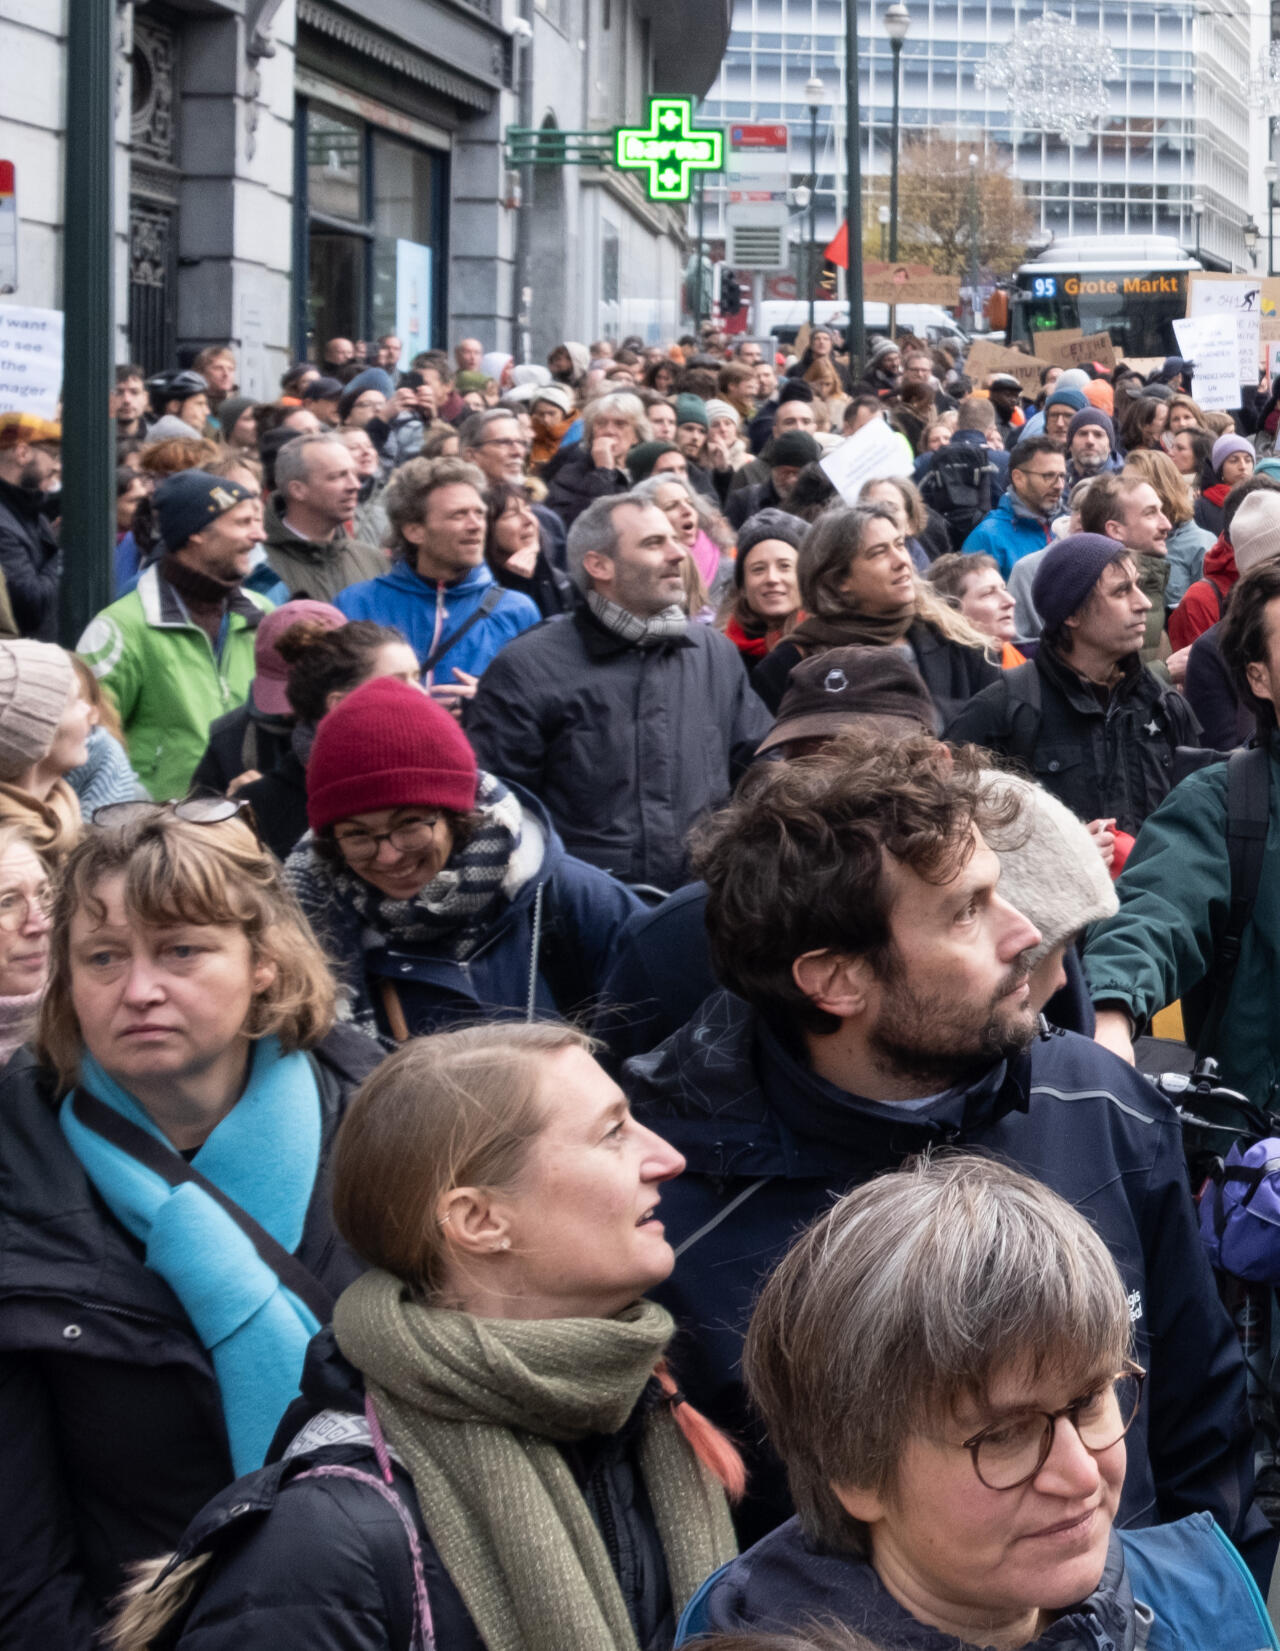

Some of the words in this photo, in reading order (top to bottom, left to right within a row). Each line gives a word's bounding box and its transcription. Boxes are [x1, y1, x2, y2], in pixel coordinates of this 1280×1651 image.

[1034, 278, 1055, 296] 95
[1064, 277, 1118, 295] Grote
[1123, 276, 1178, 292] Markt
[7, 318, 47, 331] want
[15, 341, 43, 353] see
[1, 359, 27, 373] the
